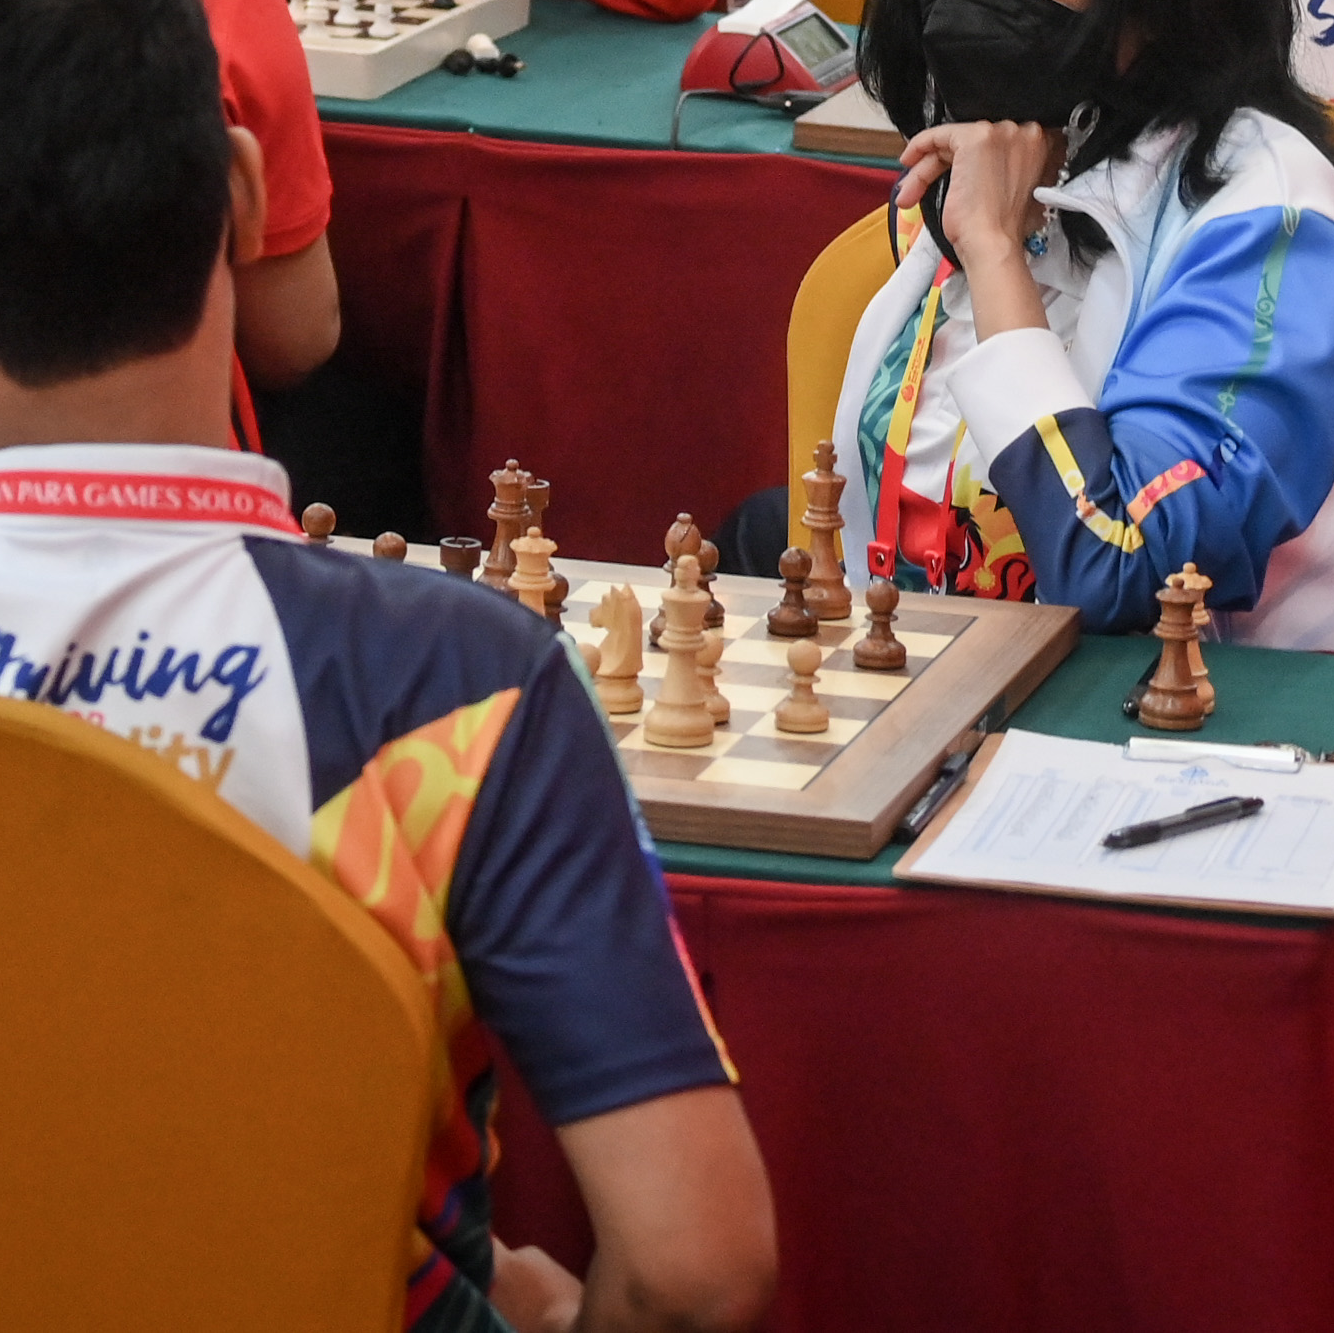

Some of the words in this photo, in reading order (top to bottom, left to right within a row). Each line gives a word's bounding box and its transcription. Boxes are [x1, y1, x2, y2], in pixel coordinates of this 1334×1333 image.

[17, 479, 78, 506] PARA
[82, 481, 183, 510] GAMES
[186, 487, 254, 515] SOLO
